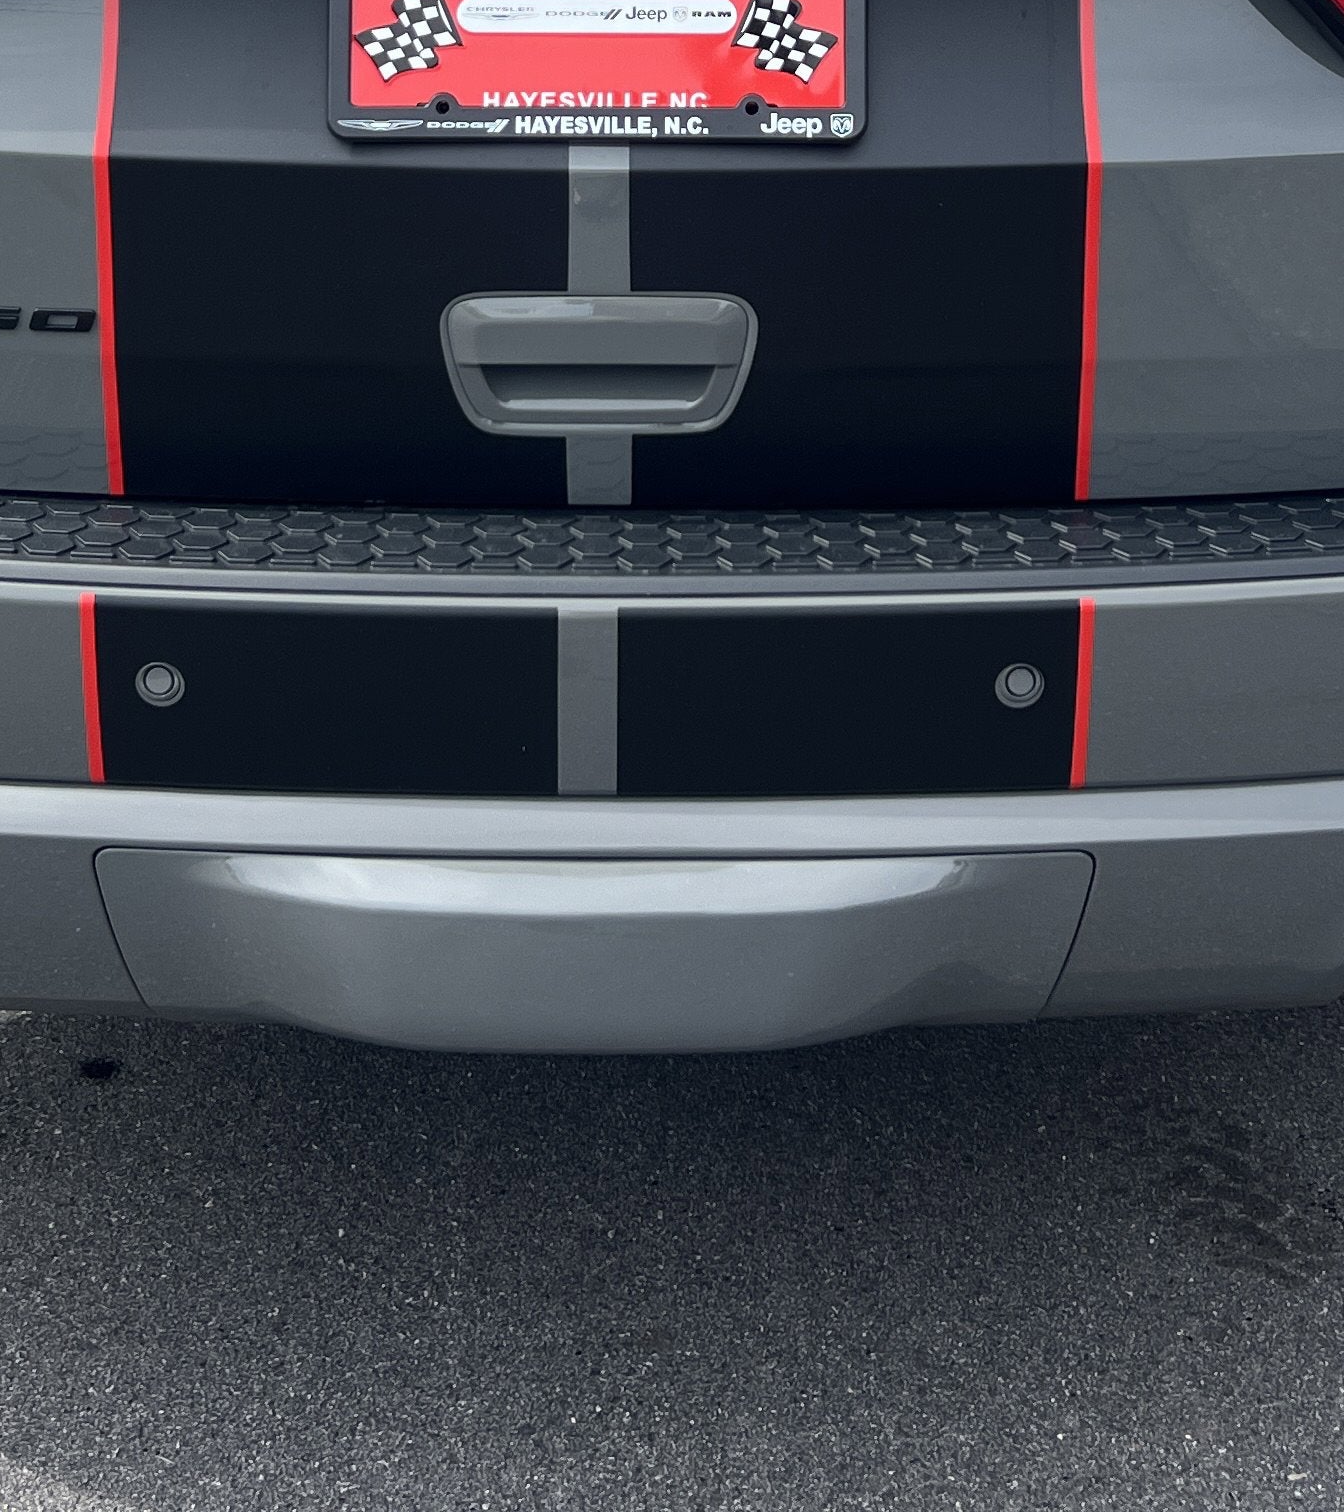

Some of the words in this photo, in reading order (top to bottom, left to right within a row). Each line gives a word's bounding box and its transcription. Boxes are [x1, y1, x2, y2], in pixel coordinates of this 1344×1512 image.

[625, 6, 668, 22] Jeep
[690, 10, 733, 19] RAM
[515, 115, 658, 138] HAYESVILLE,
[664, 116, 709, 135] N.C.
[760, 112, 823, 138] Jeep
